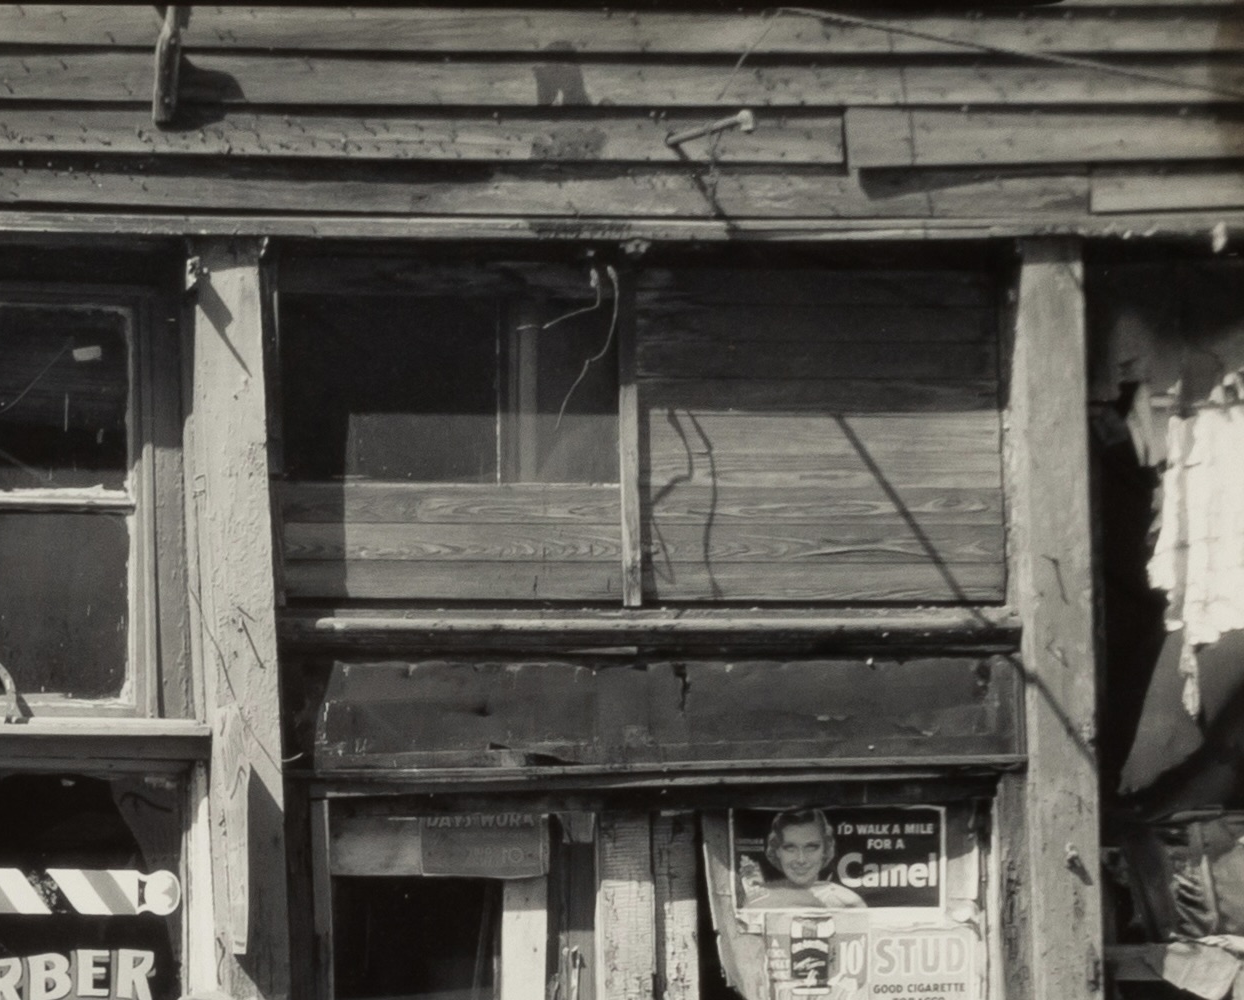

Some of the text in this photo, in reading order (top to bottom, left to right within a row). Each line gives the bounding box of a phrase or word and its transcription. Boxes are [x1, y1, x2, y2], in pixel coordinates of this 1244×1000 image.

[837, 822, 934, 835] I'D WALK A MILE
[867, 838, 905, 850] FOR A
[836, 851, 938, 888] Camel
[874, 936, 966, 975] STUD
[873, 982, 966, 995] GOOD CIGARETTE
